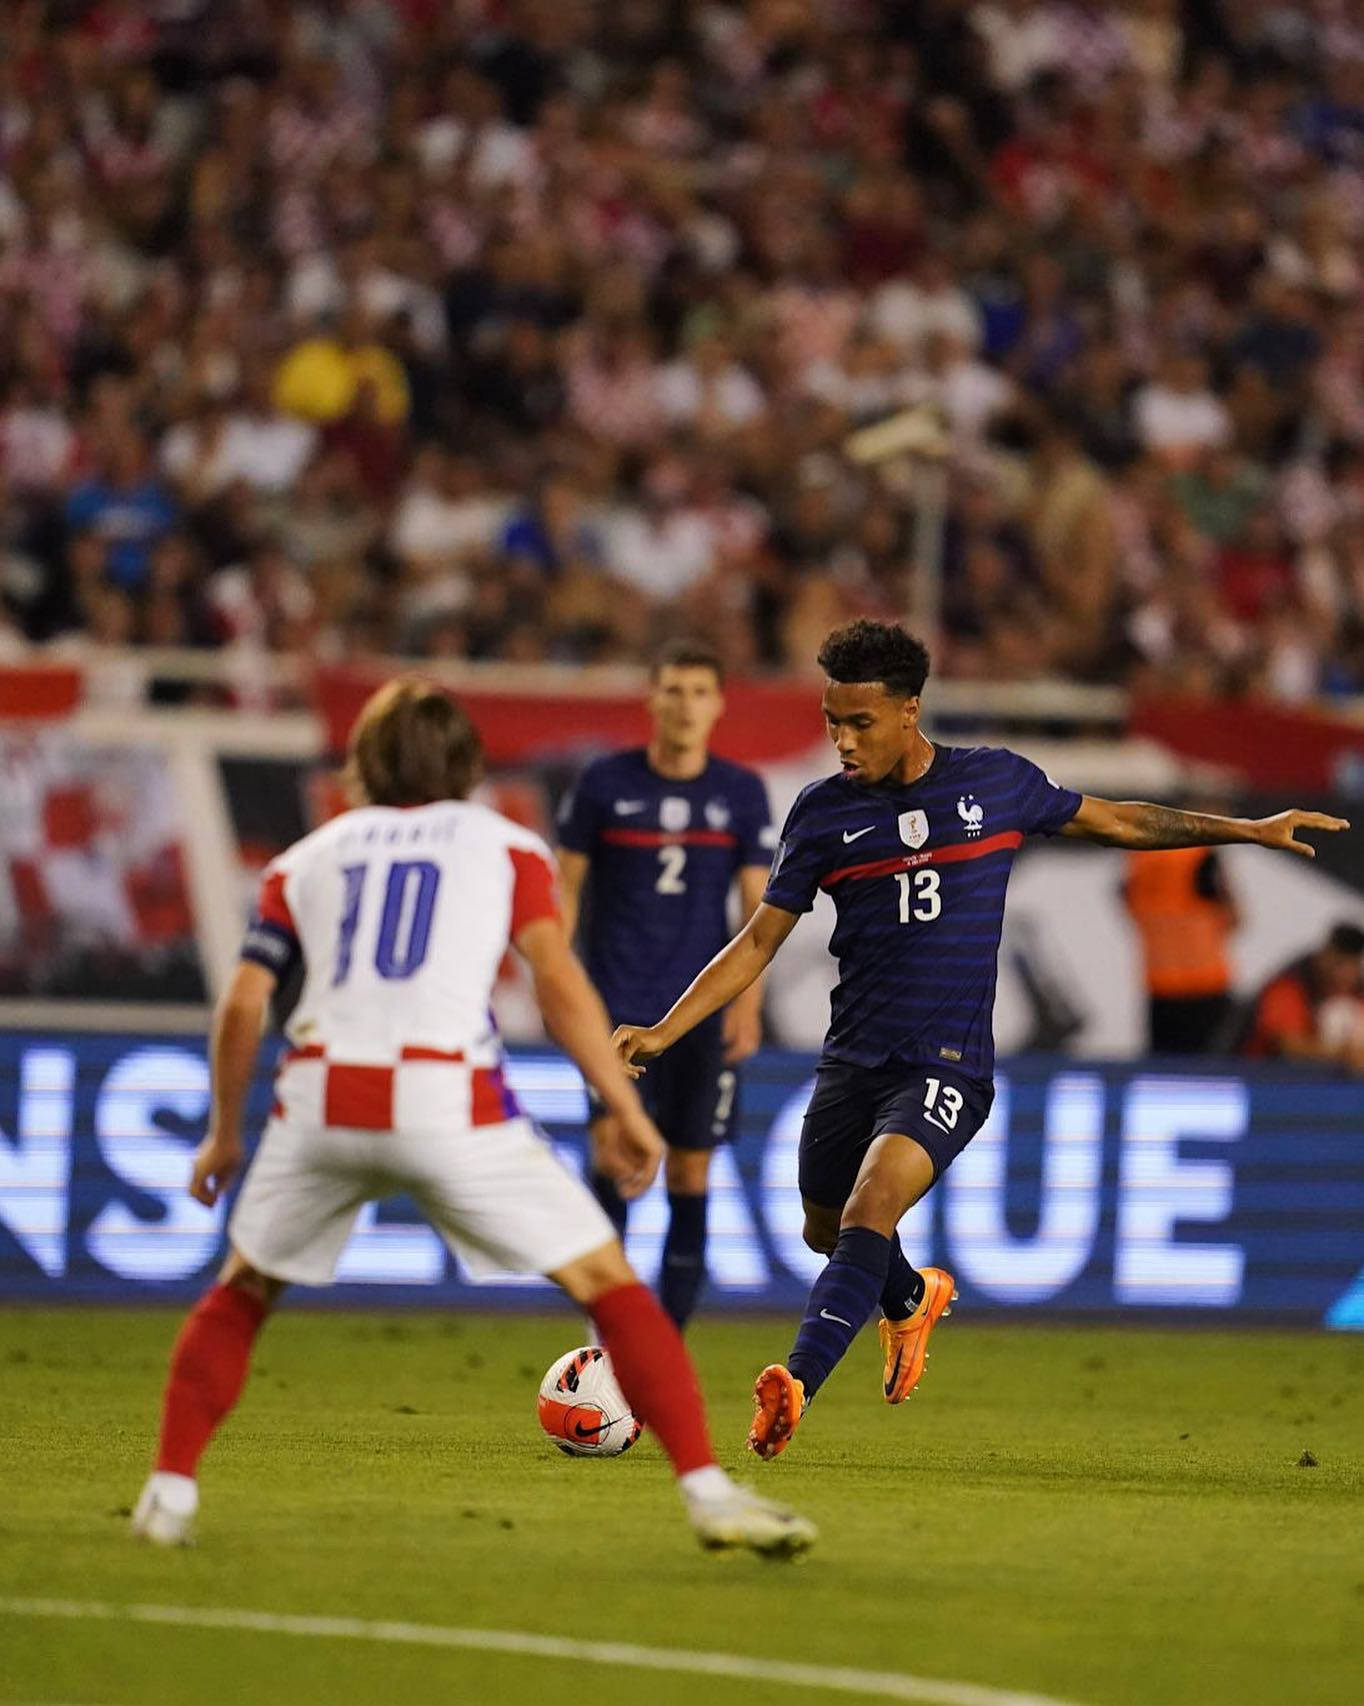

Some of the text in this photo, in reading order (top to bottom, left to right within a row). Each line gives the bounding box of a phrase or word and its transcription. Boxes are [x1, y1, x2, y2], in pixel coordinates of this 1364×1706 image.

[655, 846, 687, 895] 2
[894, 869, 942, 924] 13
[332, 860, 441, 987] 10
[923, 1077, 964, 1130] 13
